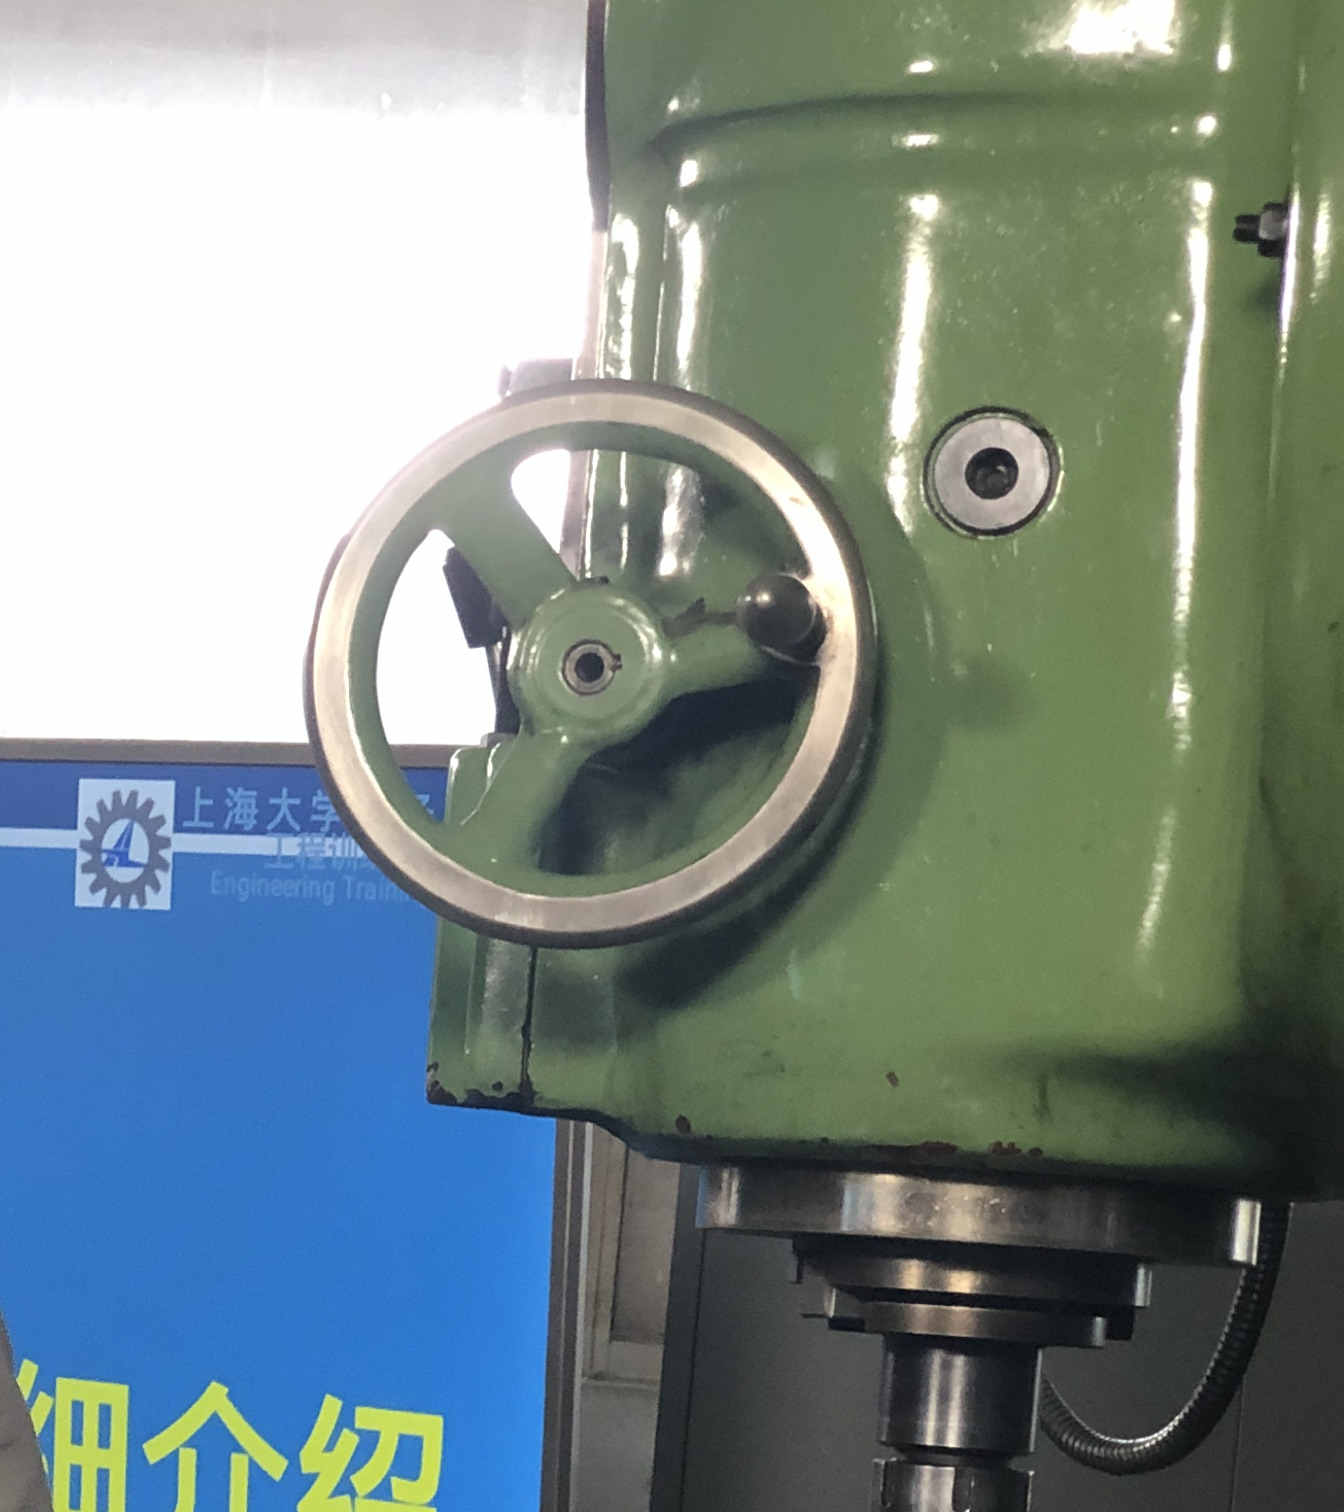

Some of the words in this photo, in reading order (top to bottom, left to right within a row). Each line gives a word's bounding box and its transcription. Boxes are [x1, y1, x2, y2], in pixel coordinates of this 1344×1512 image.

[182, 786, 341, 832] 上海大学
[210, 870, 336, 905] Engineering
